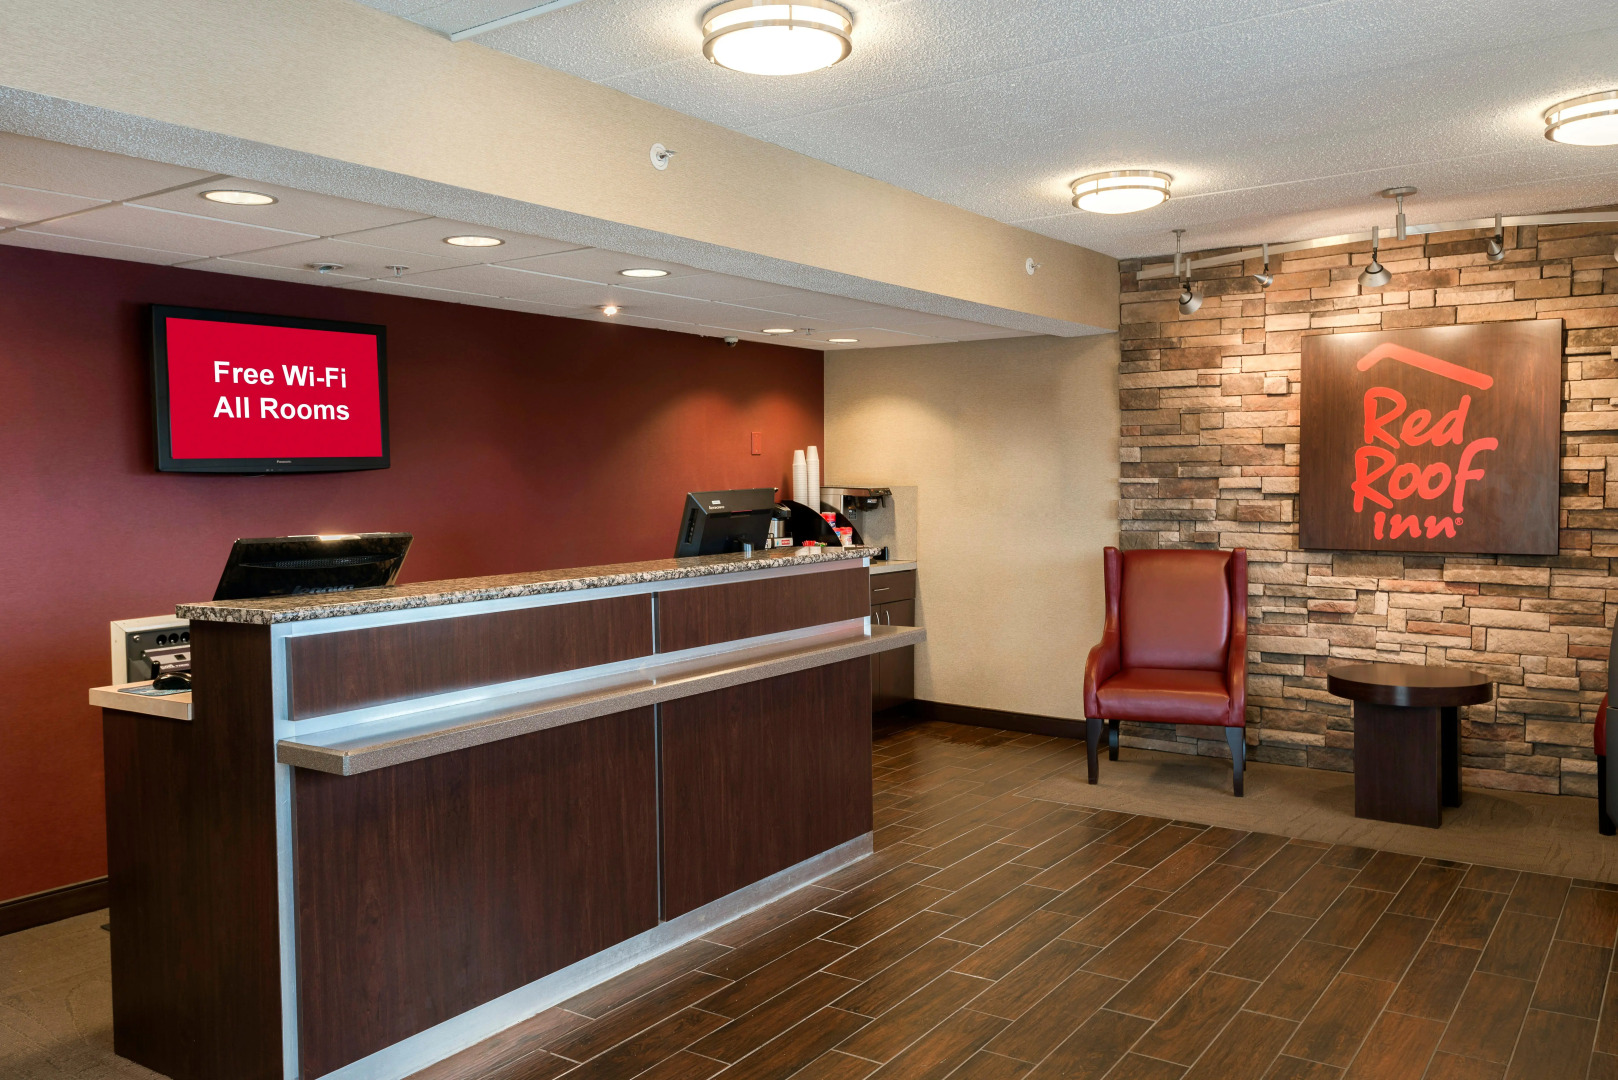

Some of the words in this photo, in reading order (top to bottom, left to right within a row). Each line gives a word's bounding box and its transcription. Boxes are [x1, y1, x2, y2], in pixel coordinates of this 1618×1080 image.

[213, 360, 274, 386] Free
[281, 364, 347, 389] Wi-Fi
[213, 395, 250, 419] All
[260, 397, 350, 421] Rooms
[1364, 386, 1472, 449] Red
[1351, 437, 1499, 514] Roof
